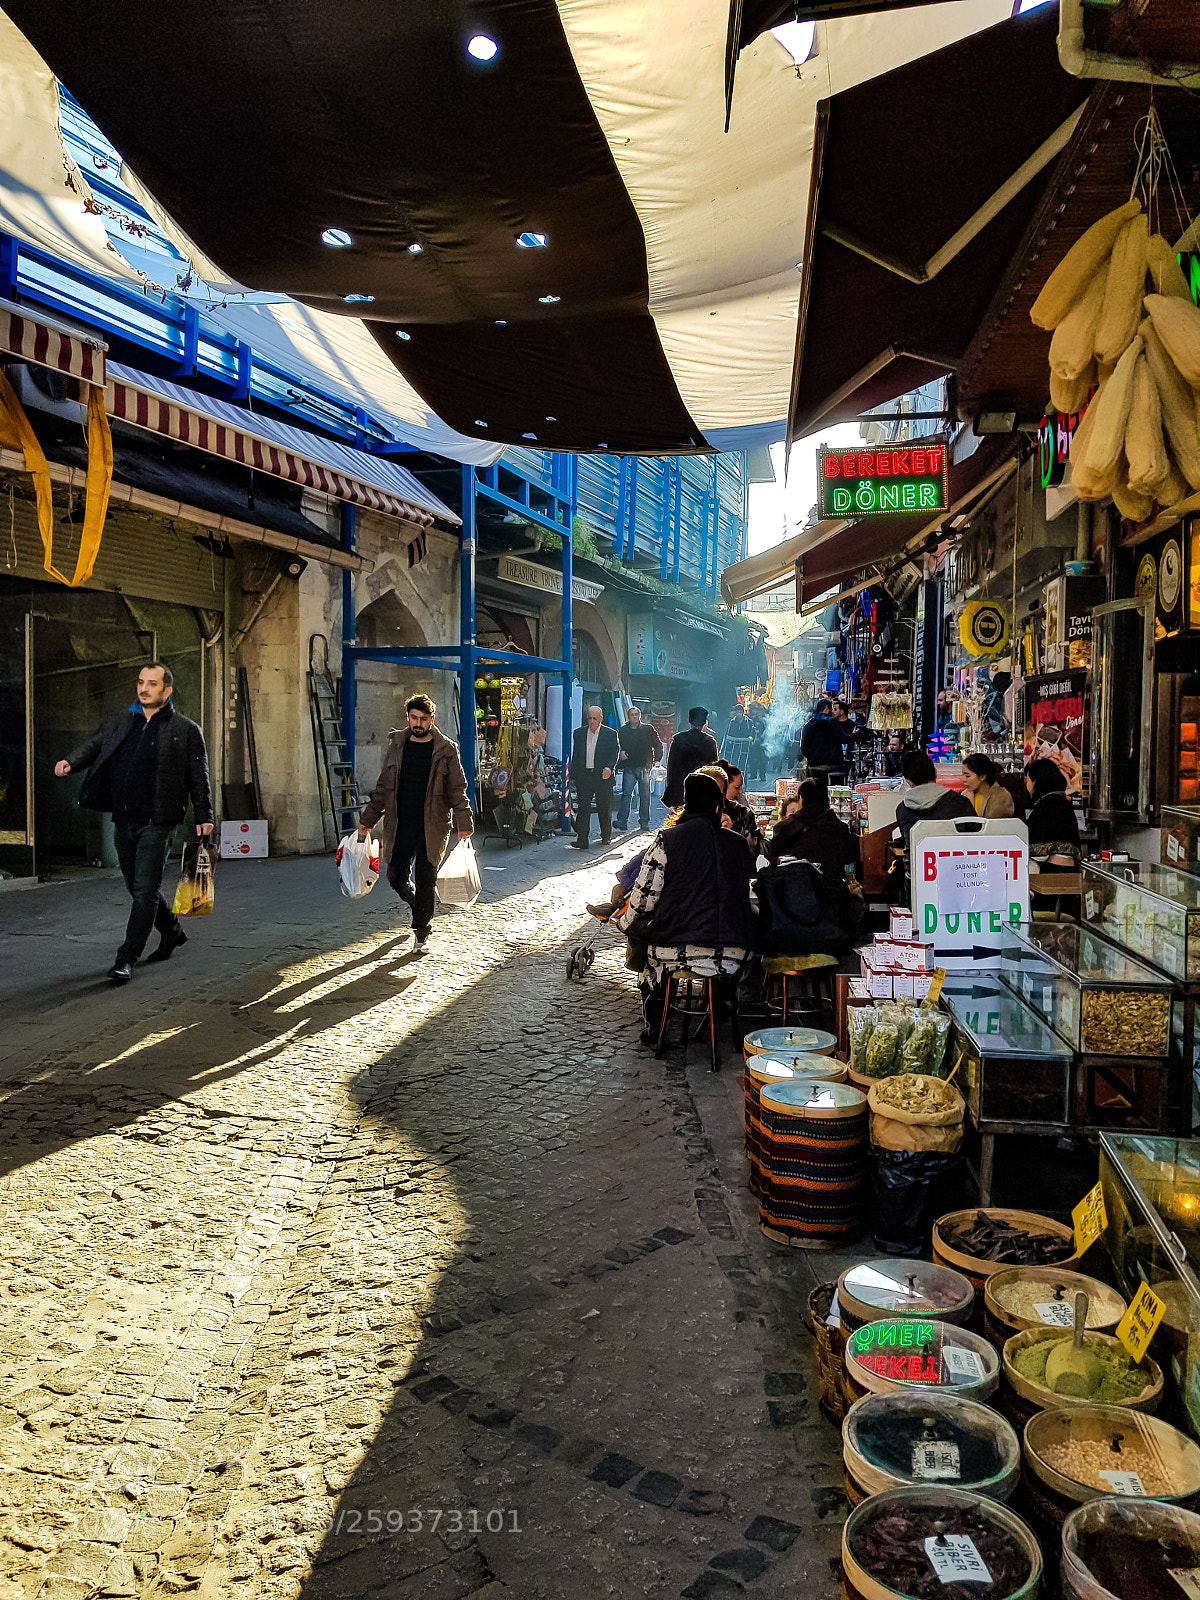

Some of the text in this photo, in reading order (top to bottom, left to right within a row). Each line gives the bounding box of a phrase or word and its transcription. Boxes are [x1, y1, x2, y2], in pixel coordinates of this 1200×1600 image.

[823, 449, 942, 479] BEREKET
[833, 480, 937, 511] DÖNER
[505, 561, 539, 583] TREASURE
[1141, 1290, 1158, 1318] KINA
[957, 1543, 984, 1572] SİVRİ
